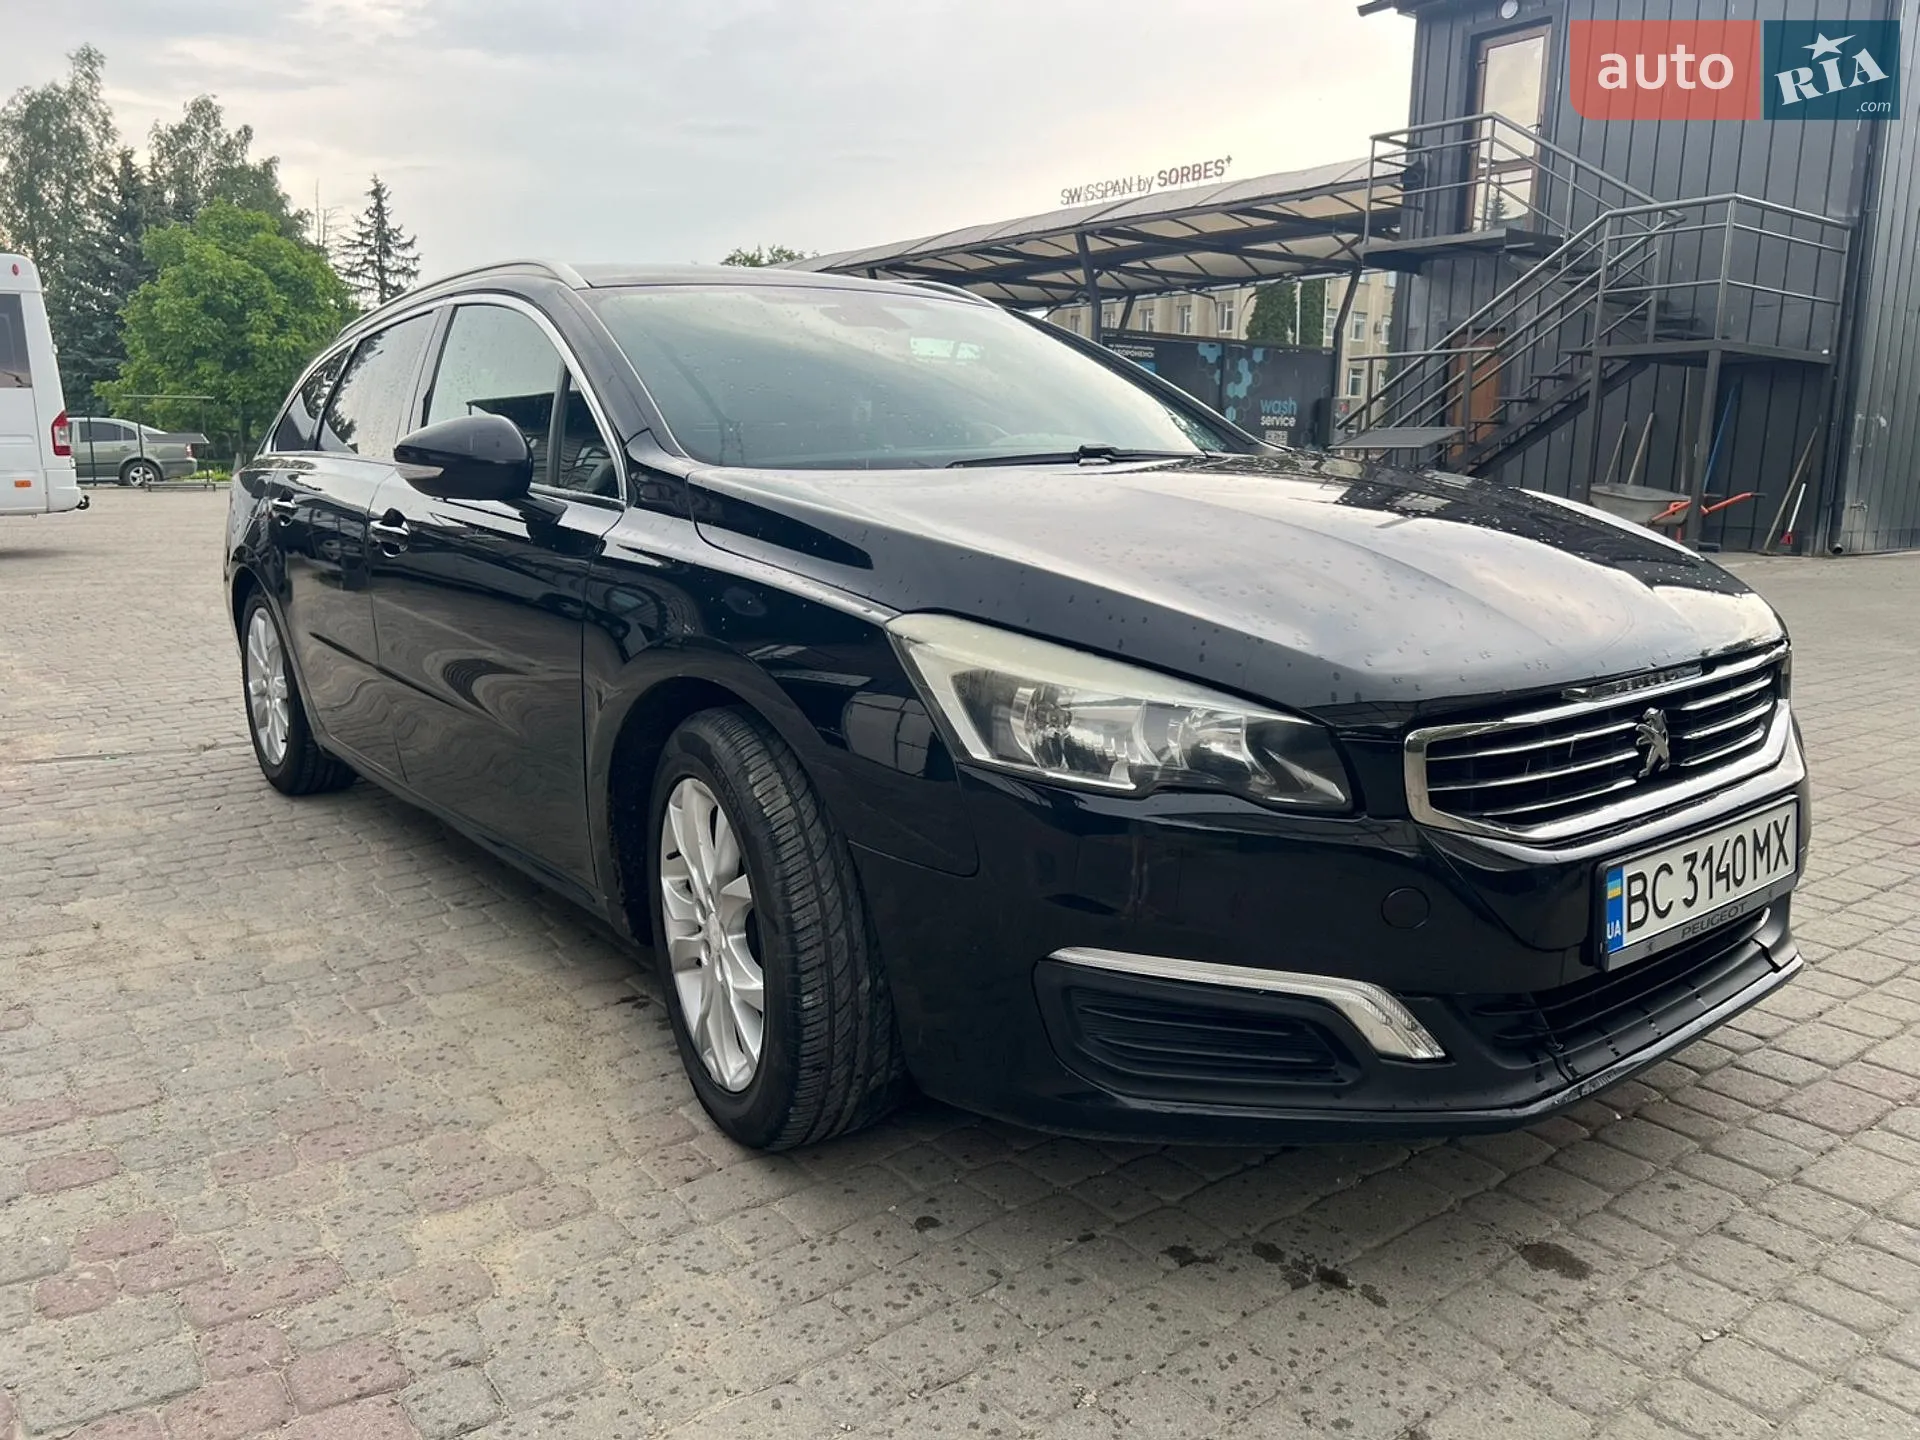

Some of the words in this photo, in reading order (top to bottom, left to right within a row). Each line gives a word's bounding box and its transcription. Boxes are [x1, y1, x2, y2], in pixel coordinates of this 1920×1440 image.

[1137, 174, 1154, 193] by
[1260, 396, 1297, 416] wash
[1260, 415, 1296, 427] service
[1626, 862, 1674, 932] BC
[1682, 833, 1747, 909] 3140
[1752, 814, 1790, 881] MX
[1606, 920, 1622, 940] UA
[1680, 902, 1748, 939] PEUGEOT
